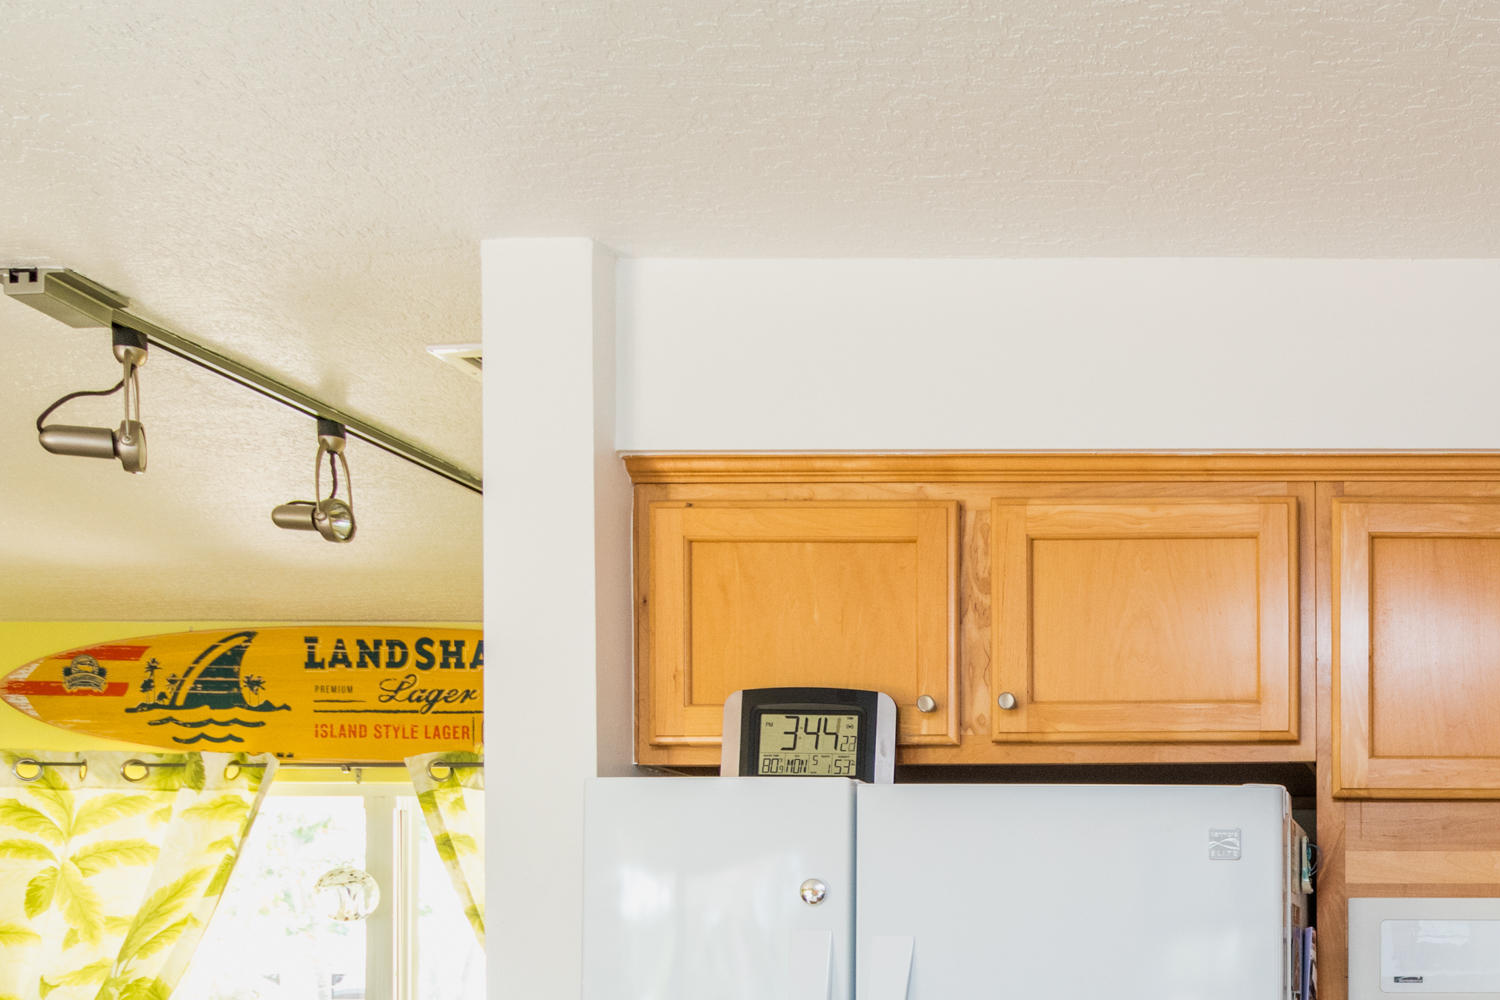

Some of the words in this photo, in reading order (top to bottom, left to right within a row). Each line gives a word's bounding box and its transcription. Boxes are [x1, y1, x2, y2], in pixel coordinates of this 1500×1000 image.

[314, 685, 353, 694] PREMIUM
[378, 674, 478, 714] Lager
[314, 723, 368, 739] ISLAND
[373, 724, 419, 740] STYLE
[424, 725, 471, 740] LAGER
[785, 759, 808, 774] MON
